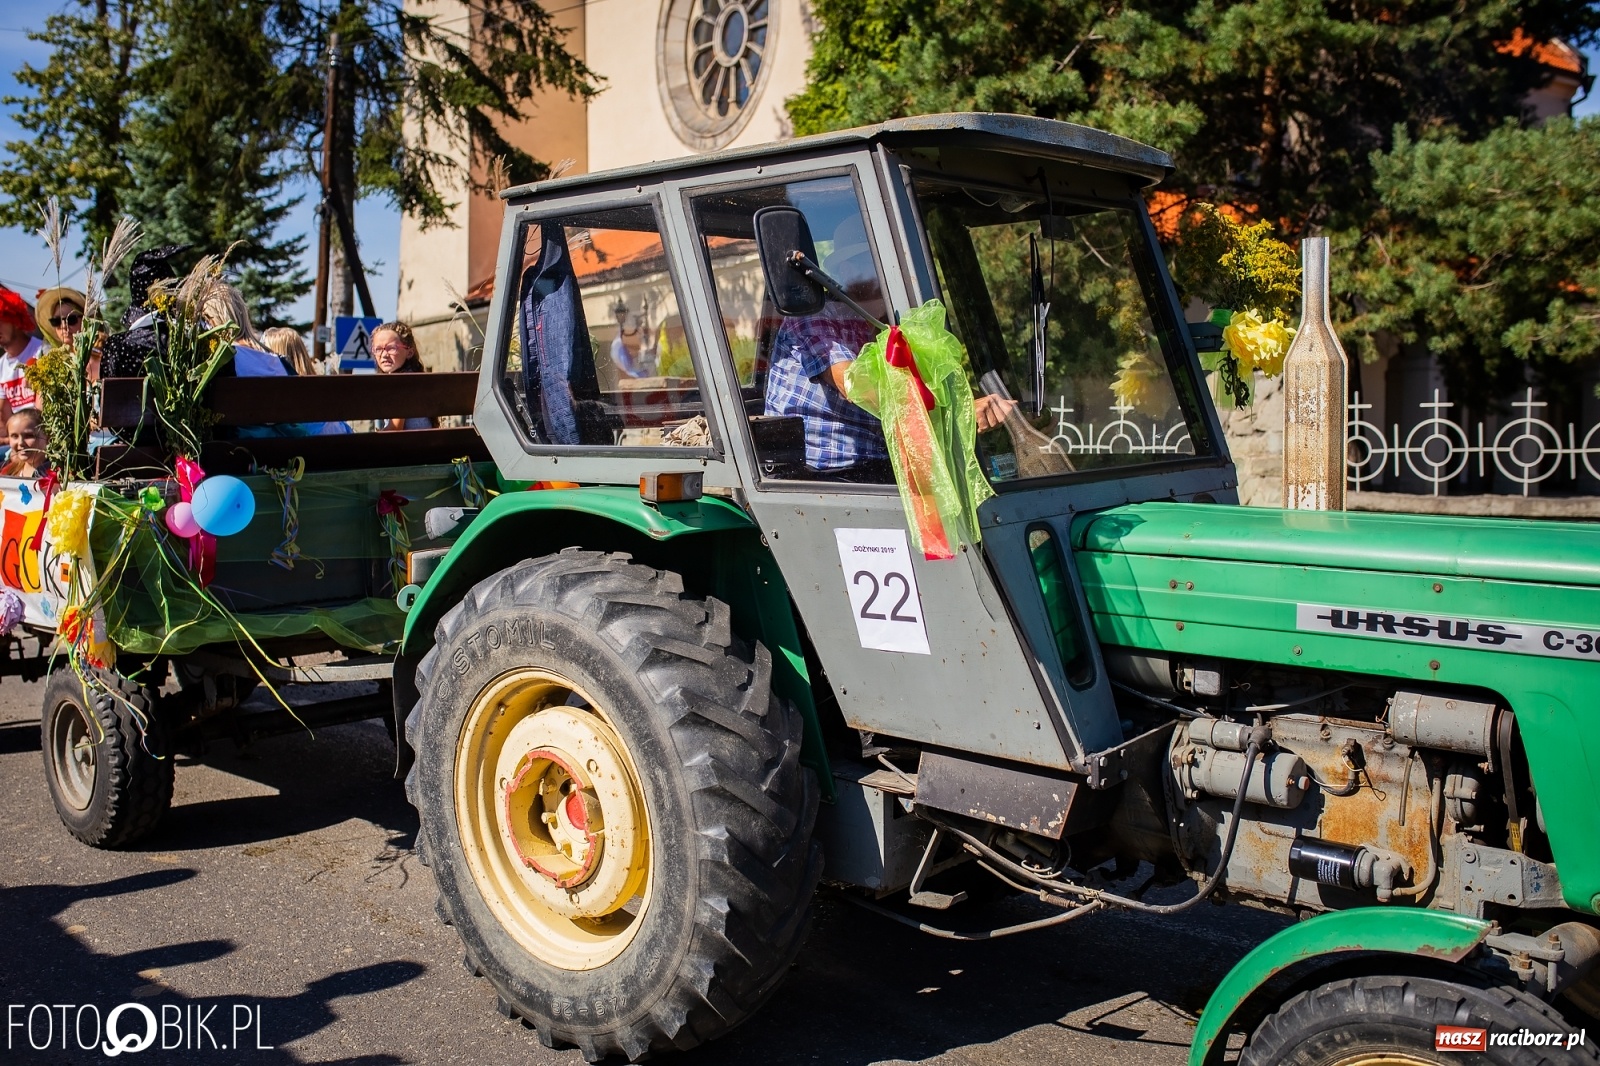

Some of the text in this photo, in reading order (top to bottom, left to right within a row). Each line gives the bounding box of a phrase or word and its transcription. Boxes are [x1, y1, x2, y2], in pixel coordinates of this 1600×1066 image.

[853, 570, 918, 623] 22
[453, 618, 556, 676] STOMIL
[1328, 609, 1509, 645] URSUS
